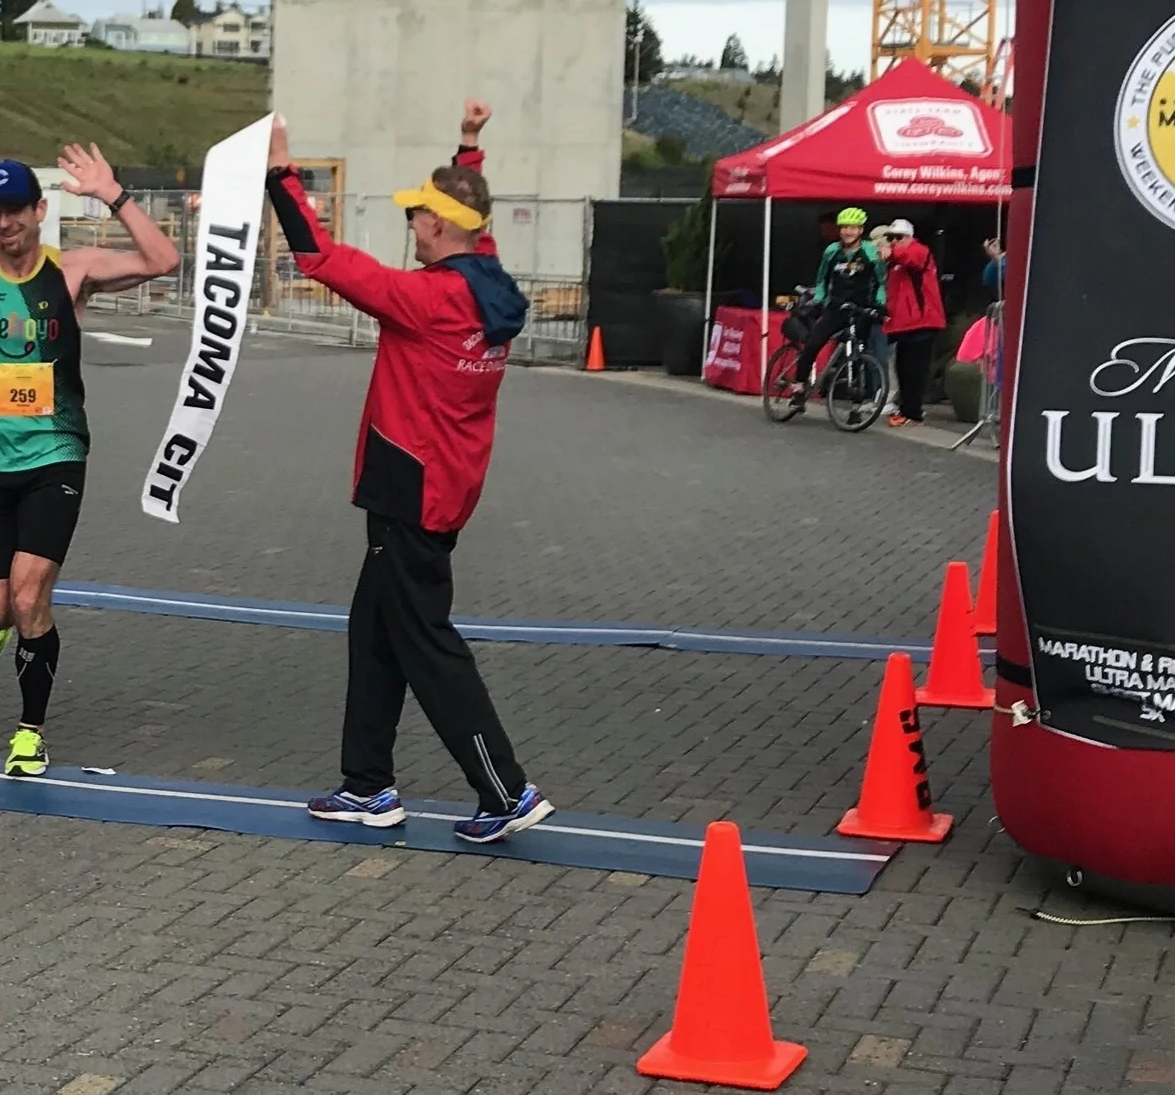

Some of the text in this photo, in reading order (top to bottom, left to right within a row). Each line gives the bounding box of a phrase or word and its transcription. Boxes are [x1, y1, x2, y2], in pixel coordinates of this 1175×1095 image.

[882, 165, 918, 180] Corey
[149, 221, 251, 512] TACOMA CIT
[10, 388, 37, 404] 259
[1038, 636, 1137, 669] MARATHON
[1140, 653, 1153, 672] &
[1085, 664, 1144, 689] ULTRA
